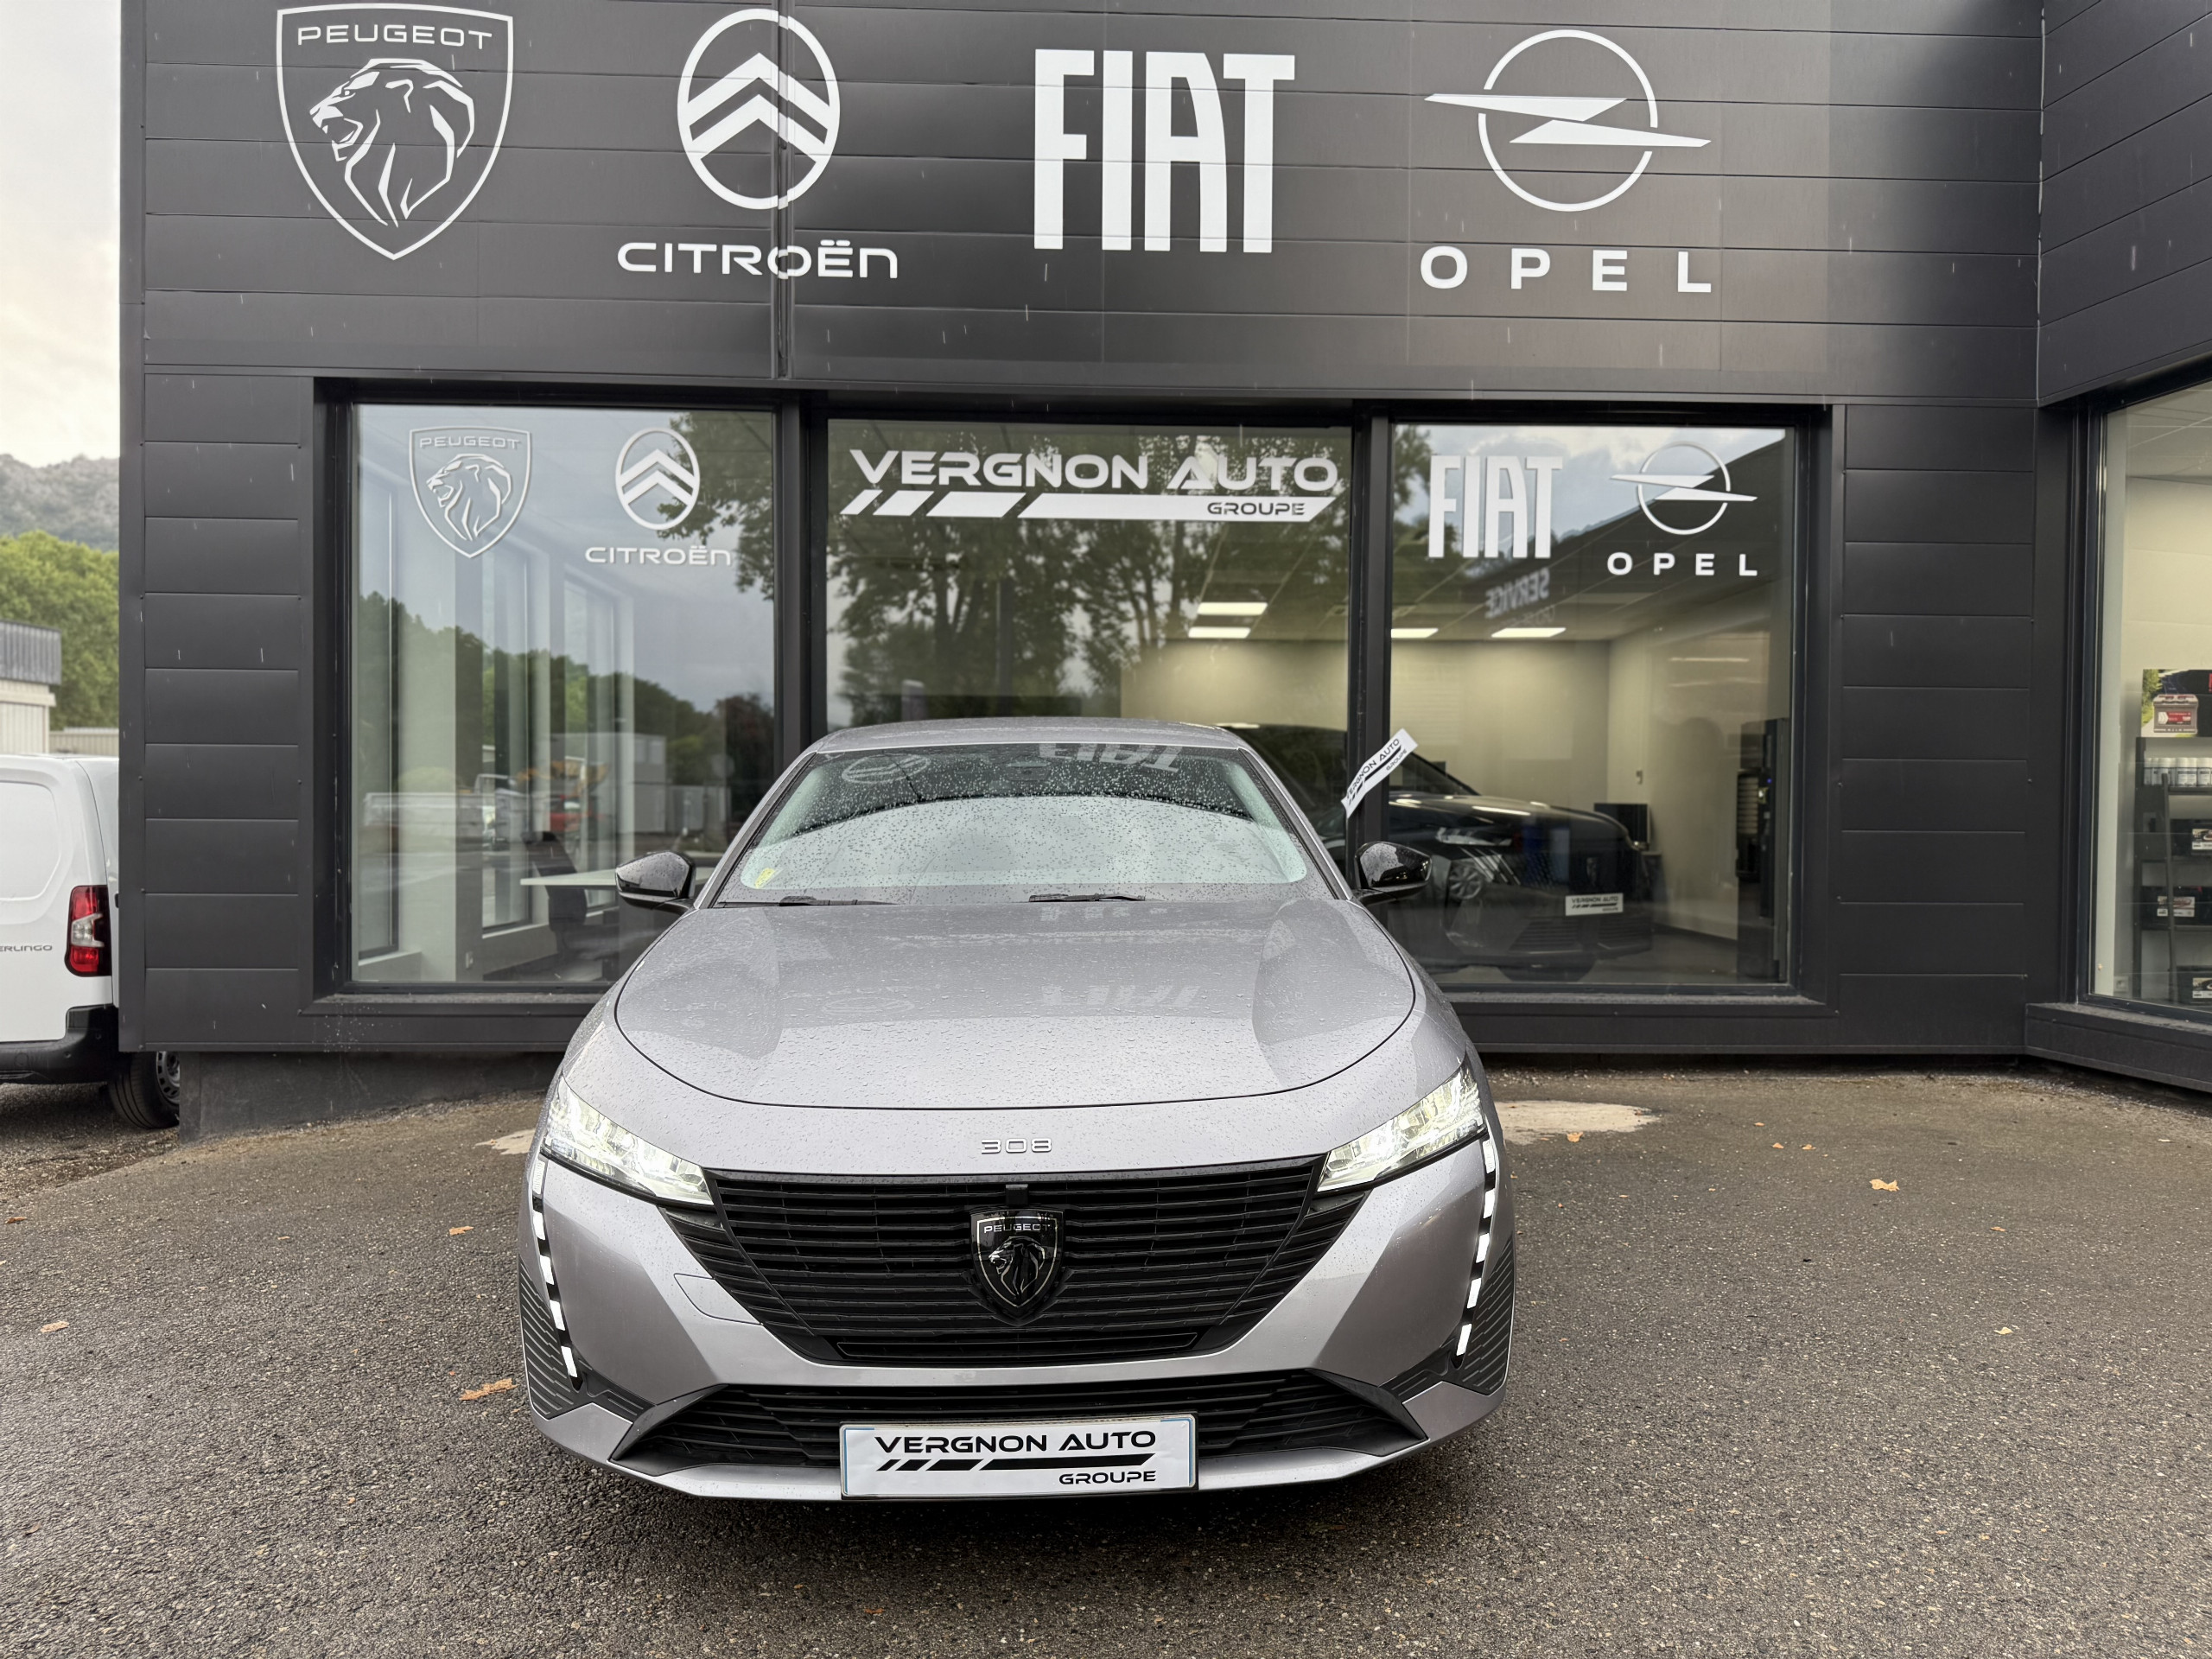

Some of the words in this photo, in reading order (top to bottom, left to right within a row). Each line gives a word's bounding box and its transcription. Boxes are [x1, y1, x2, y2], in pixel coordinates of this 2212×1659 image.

[298, 24, 493, 50] PEUGEOT
[1033, 48, 1295, 253] FIAT
[617, 239, 899, 279] CITROËN
[1420, 245, 1712, 293] OPEL
[419, 435, 522, 451] PEUGEOT
[849, 448, 1149, 489] VERGNON
[1166, 454, 1338, 492] AUTO
[1207, 501, 1306, 517] GROUPE
[1427, 454, 1563, 559] FIAT
[584, 545, 732, 567] CITROËN
[1606, 551, 1758, 576] OPEL
[1379, 738, 1401, 761] AUTO
[981, 1137, 1052, 1154] 308
[983, 1223, 1052, 1234] PEUGEOT
[874, 1434, 1048, 1453] VERGNON
[1058, 1430, 1157, 1452] AUTO
[1058, 1470, 1157, 1485] GROUPE
